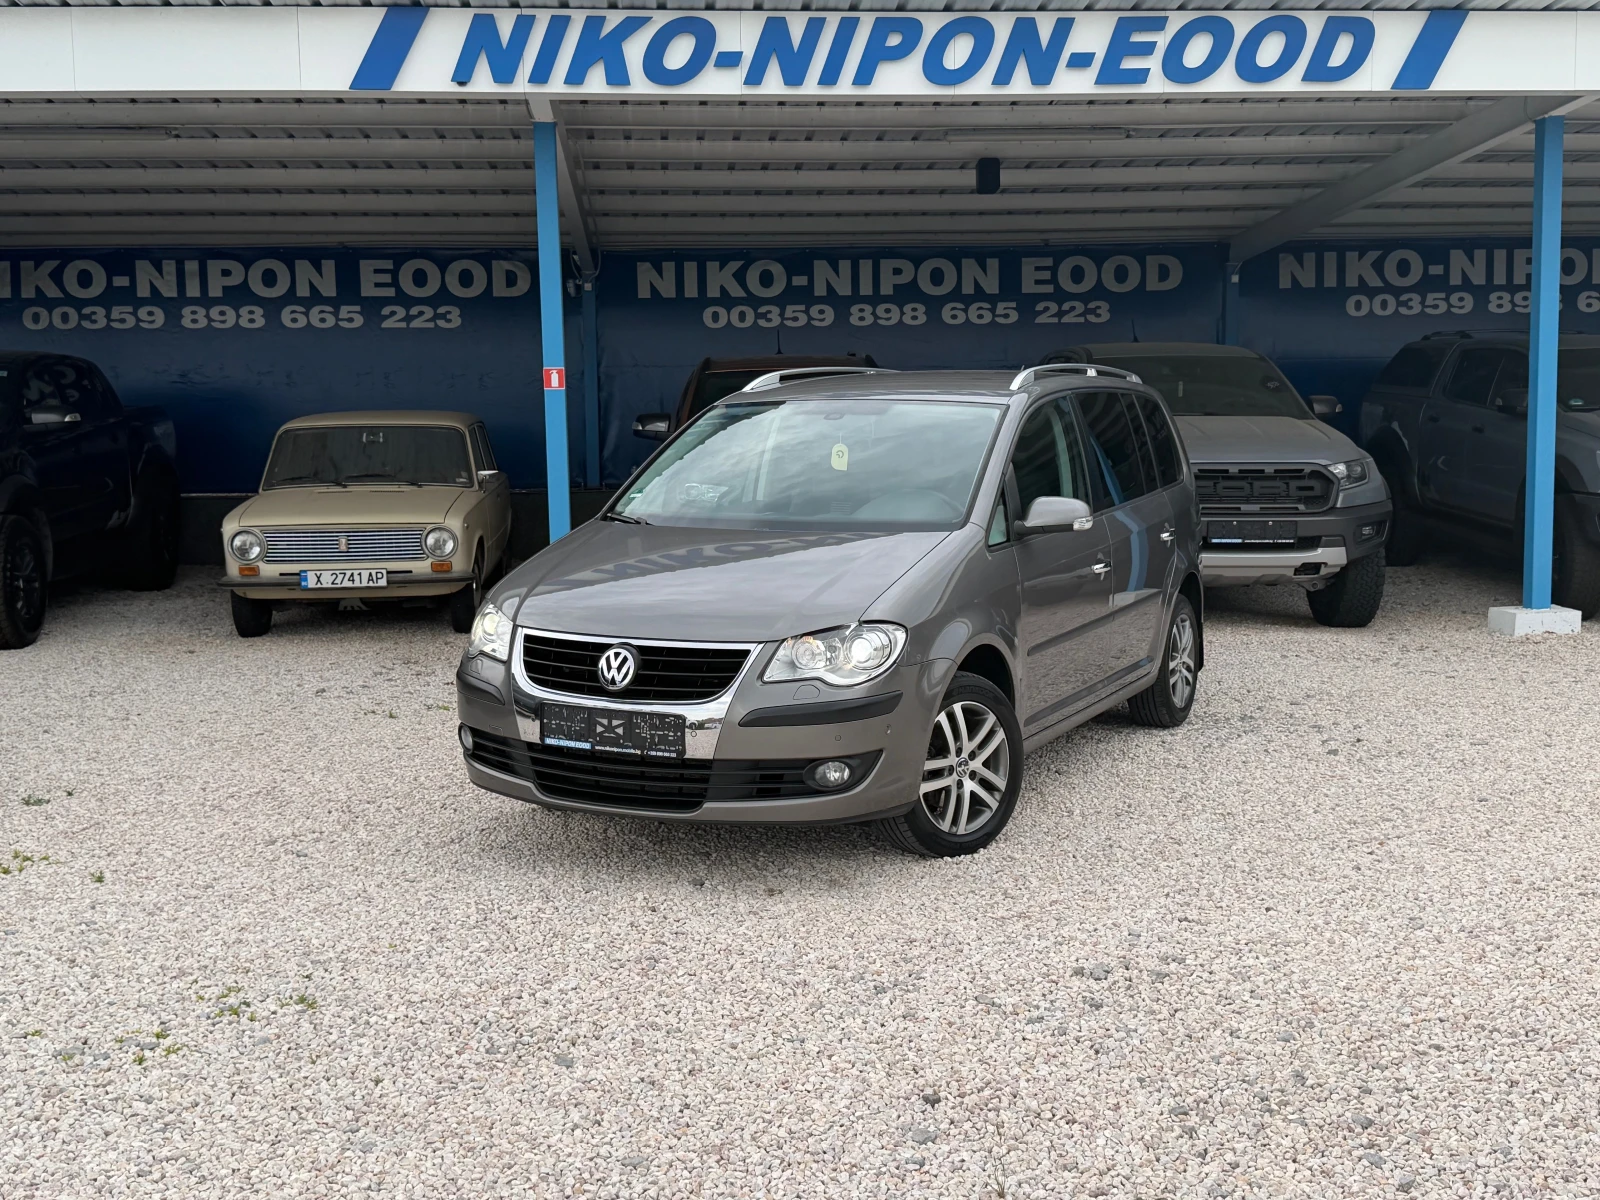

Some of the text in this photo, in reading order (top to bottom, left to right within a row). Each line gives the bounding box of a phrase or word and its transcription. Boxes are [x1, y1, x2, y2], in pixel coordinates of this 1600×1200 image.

[451, 14, 1376, 86] NIKO-NIPON-EOOD
[0, 258, 532, 299] IKO-NIPON EOOD
[636, 255, 1184, 299] NIKO-NIPON EOOD
[1277, 247, 1600, 289] NIKO-NIPO
[22, 305, 462, 330] 00359 898 665 223
[702, 301, 1111, 329] 00359 898 665 223
[1345, 292, 1474, 317] 00359
[1487, 291, 1563, 314] 89
[314, 572, 323, 586] X
[330, 571, 363, 586] 2741
[366, 571, 384, 585] AP
